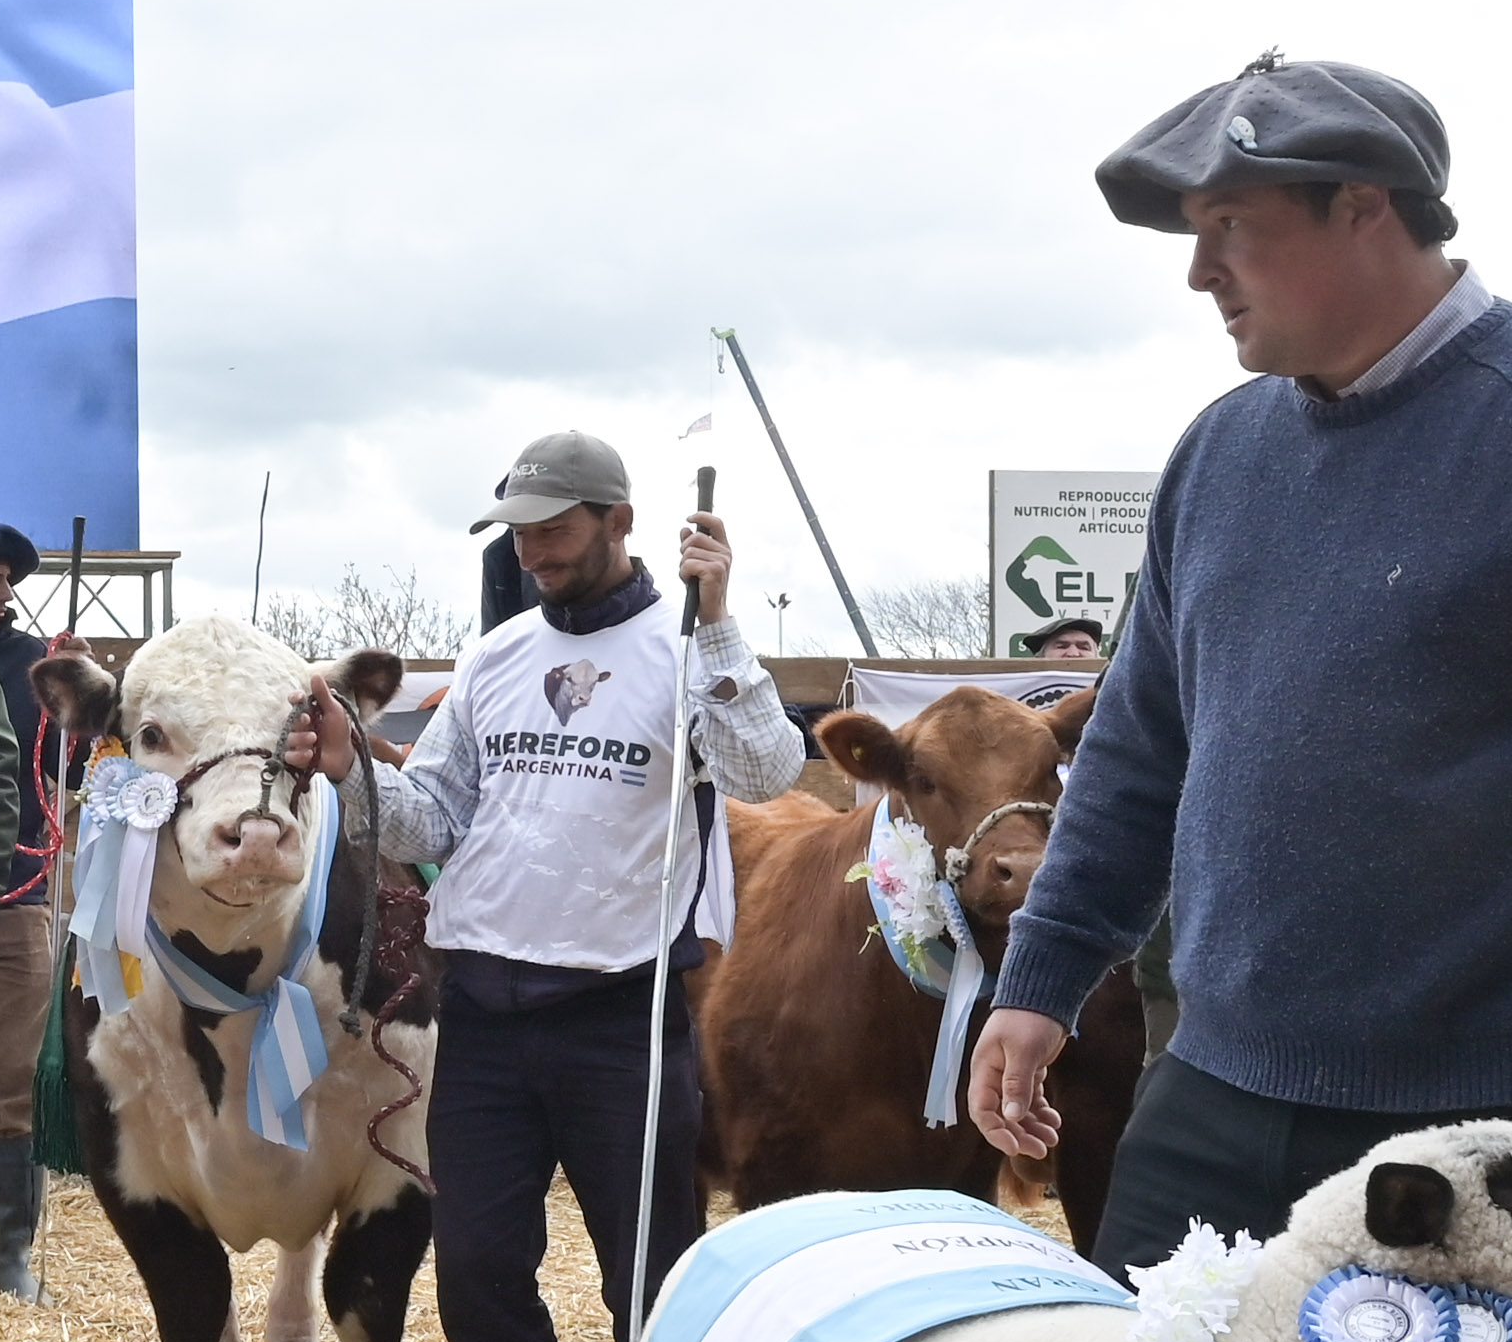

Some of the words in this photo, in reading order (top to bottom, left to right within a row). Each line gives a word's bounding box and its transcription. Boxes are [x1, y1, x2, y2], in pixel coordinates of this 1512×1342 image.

[1014, 503, 1087, 518] NUTRICIÓN
[1079, 520, 1147, 534] ARTÍCULO
[1055, 571, 1114, 603] EL
[486, 731, 651, 767] HEREFORD
[502, 759, 613, 782] ARGENTINA
